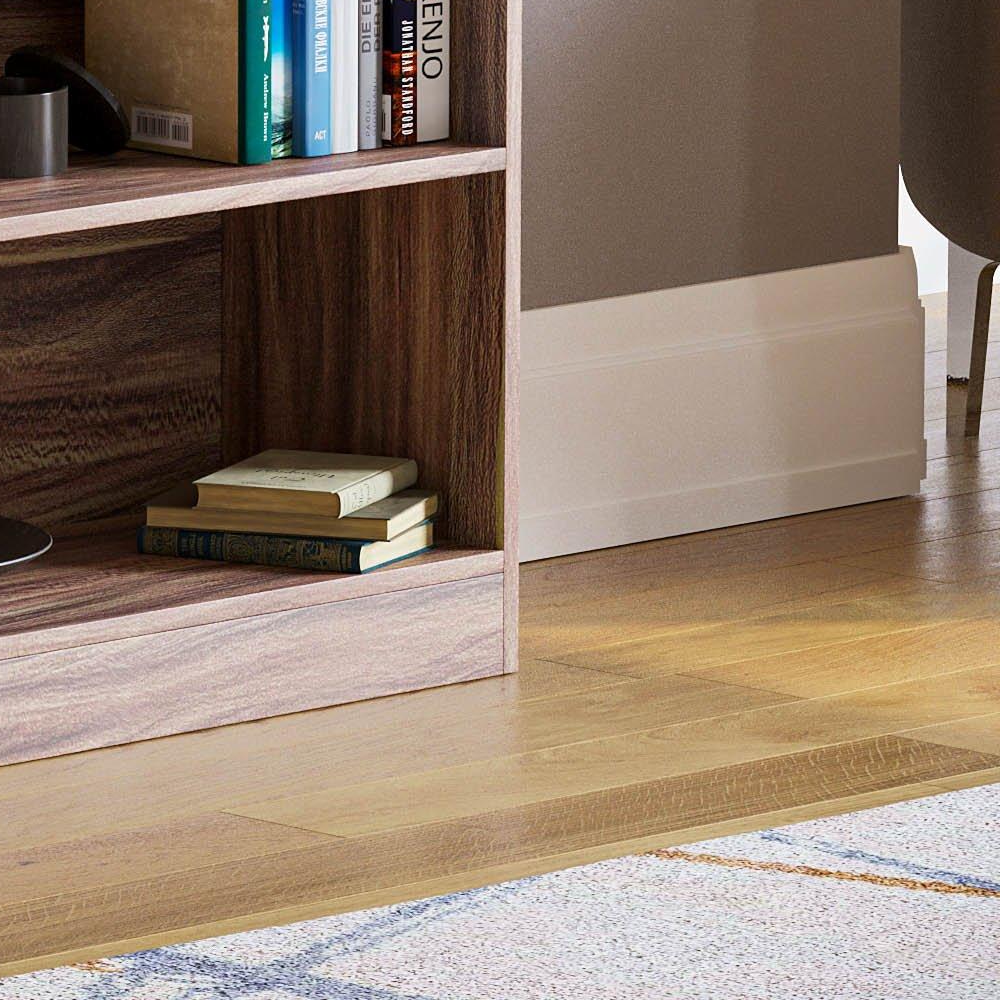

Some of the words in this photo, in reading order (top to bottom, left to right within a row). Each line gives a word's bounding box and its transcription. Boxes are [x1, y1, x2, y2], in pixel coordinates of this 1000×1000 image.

[314, 31, 328, 73] ФИАЛКИ
[361, 19, 372, 54] DIE
[401, 20, 414, 73] JONATHAN
[401, 76, 414, 136] STANDFORD
